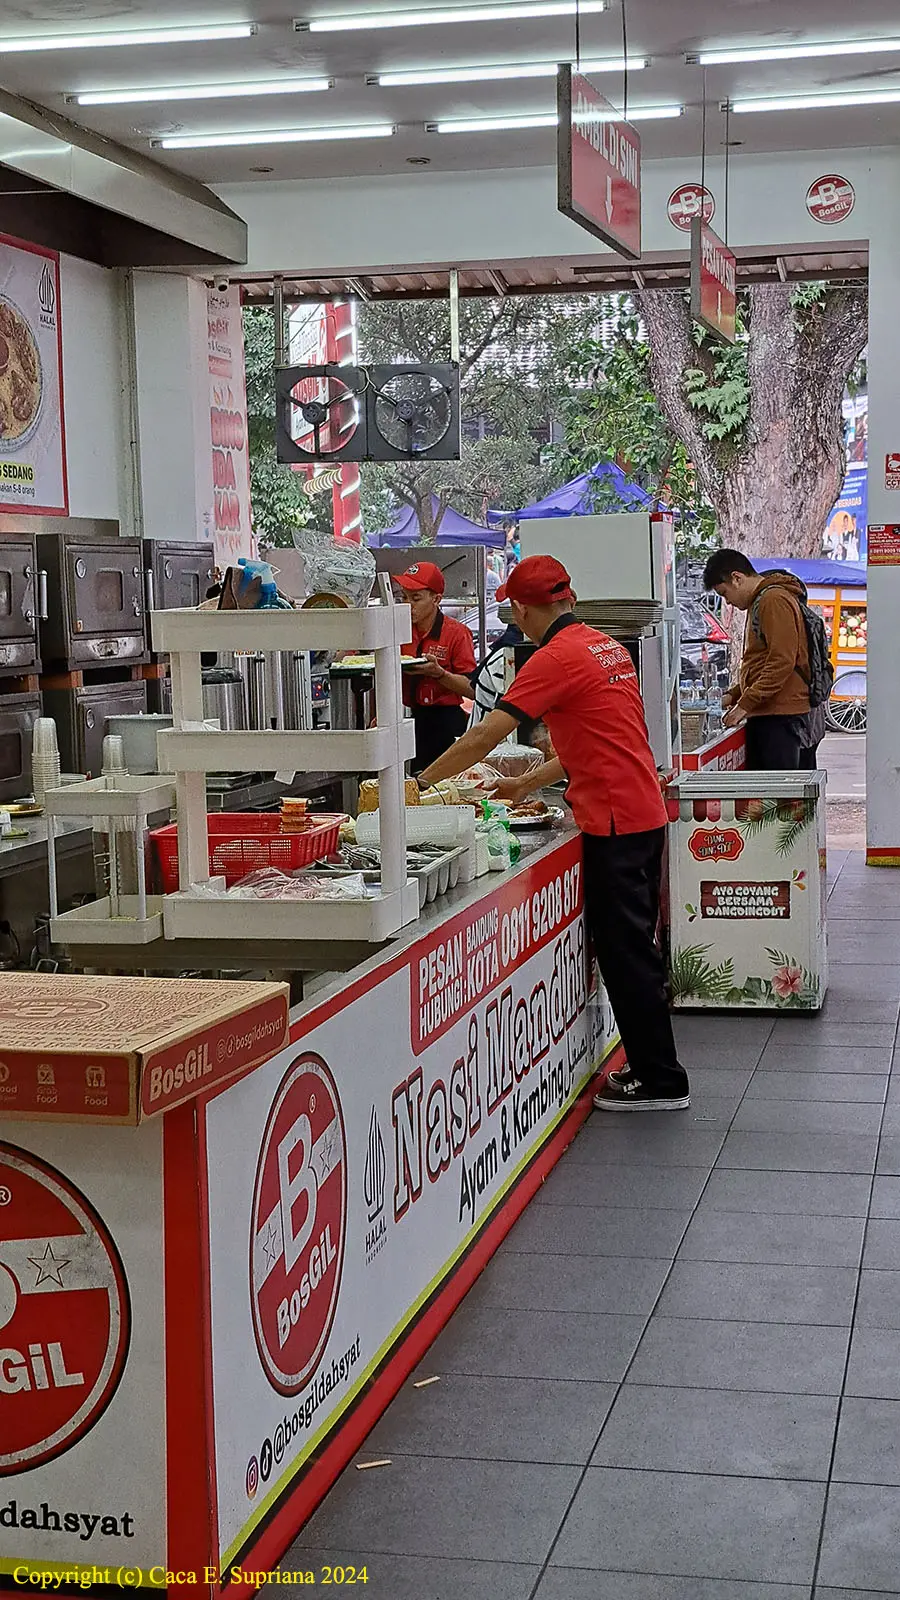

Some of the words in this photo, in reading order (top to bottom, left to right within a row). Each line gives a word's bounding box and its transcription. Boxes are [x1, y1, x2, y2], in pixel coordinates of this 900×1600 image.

[576, 91, 608, 161] AMBIL
[619, 135, 638, 190] SINI
[3, 463, 34, 481] SEDANG
[712, 885, 734, 896] AYO
[735, 885, 779, 897] GOYANG
[717, 896, 774, 907] BERSAMA
[466, 907, 499, 955] BANDUNG
[467, 939, 500, 1003] KOTA
[501, 898, 531, 968] 0811
[532, 875, 562, 943] 9208
[563, 861, 581, 918] 817
[419, 931, 463, 1005] PESAN
[0, 1084, 18, 1094] ood
[149, 1042, 213, 1103] BosGiL
[391, 1013, 482, 1224] Nasi
[486, 918, 588, 1118] Mandhi
[36, 1095, 58, 1105] Food
[84, 1095, 108, 1106] Food
[459, 1137, 498, 1225] Ayam
[501, 1104, 511, 1163] &
[511, 1056, 572, 1148] Kambing
[277, 1113, 318, 1277] B
[365, 1215, 387, 1254] HALAL
[276, 1222, 338, 1351] BosGiL
[0, 1342, 85, 1394] GiL
[273, 1333, 361, 1465] @bosgildahsyat
[0, 1501, 135, 1541] dahsyat
